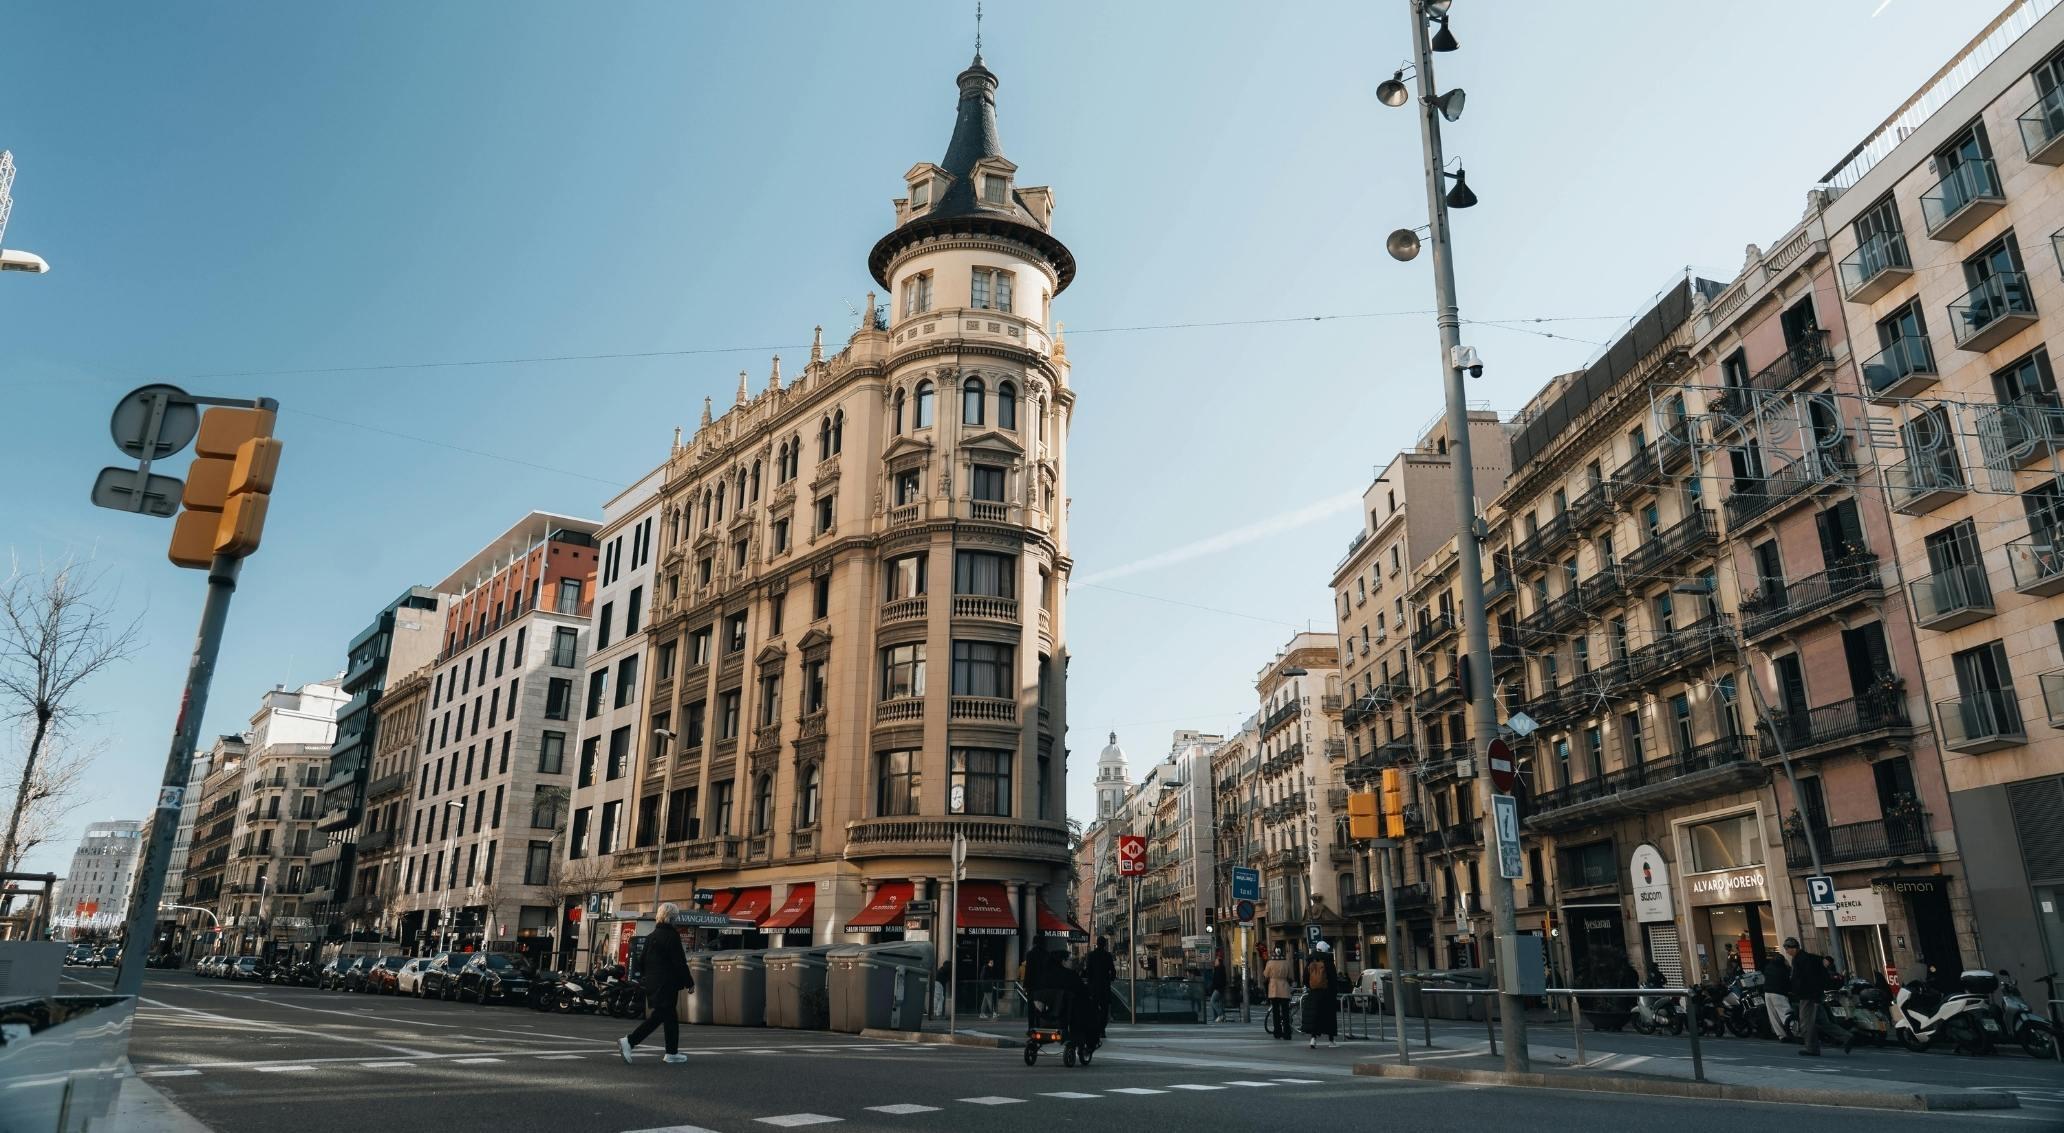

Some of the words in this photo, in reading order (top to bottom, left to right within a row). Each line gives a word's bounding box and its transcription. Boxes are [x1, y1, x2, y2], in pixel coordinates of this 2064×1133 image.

[1302, 695, 1314, 755] HOTEL
[1306, 775, 1320, 863] MIDMOST
[1128, 844, 1139, 854] M
[1693, 878, 1725, 893] ALVARO
[1725, 873, 1764, 889] MORENO
[1893, 881, 1934, 892] lemon
[1812, 880, 1828, 902] P
[590, 895, 597, 911] P
[681, 914, 727, 924] VANGUARDIA
[1044, 930, 1070, 938] MARNI
[1310, 926, 1320, 939] P
